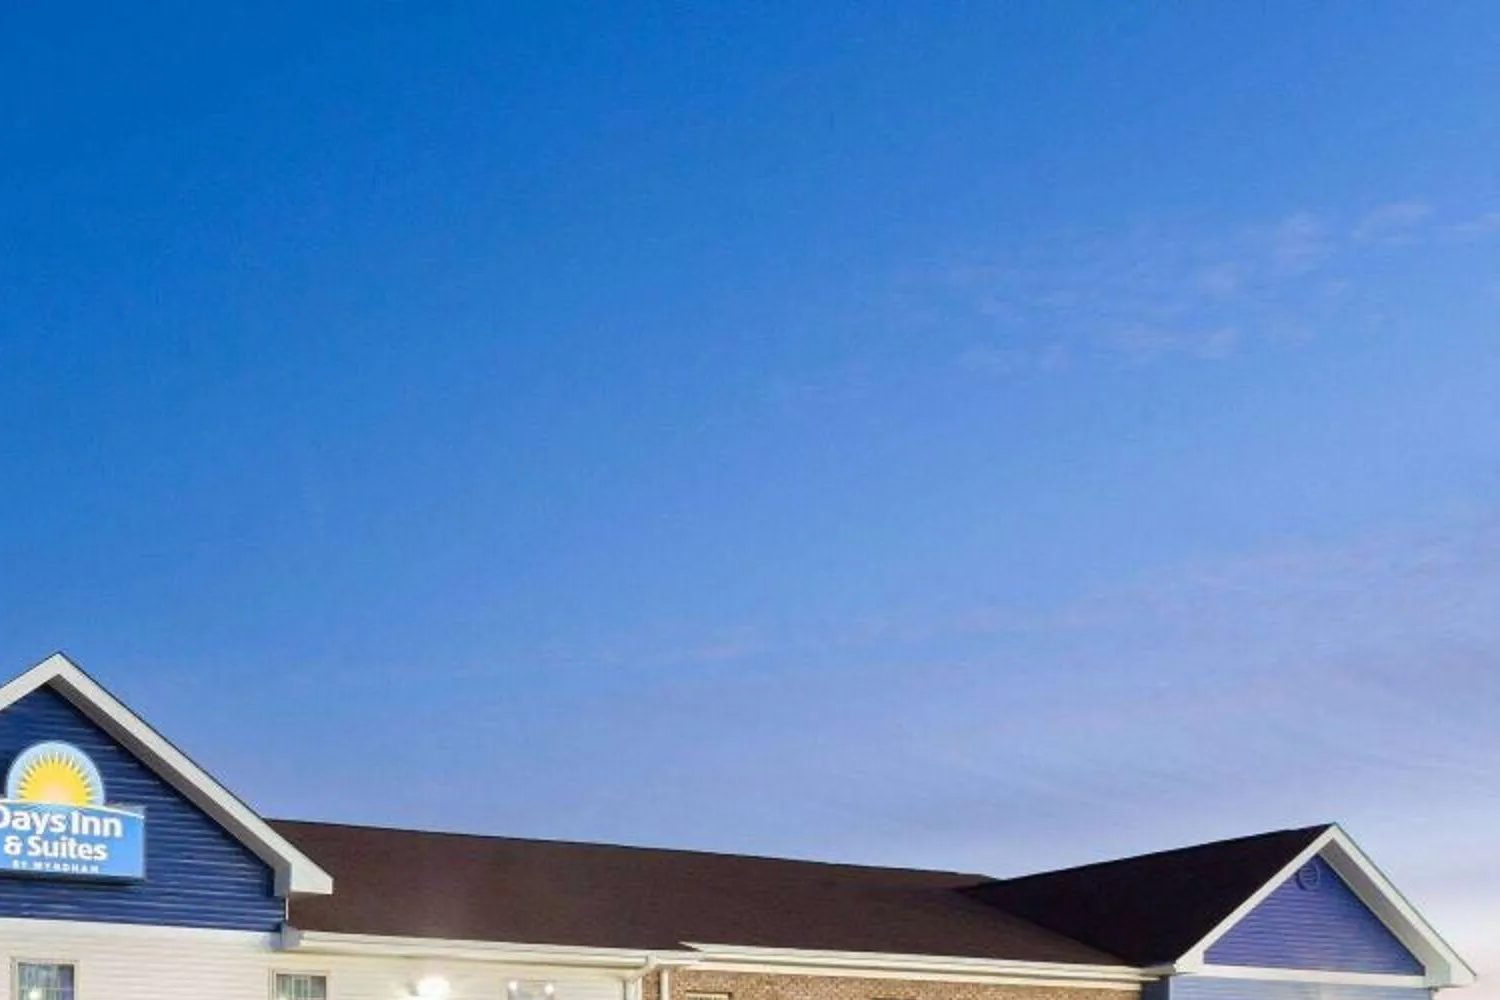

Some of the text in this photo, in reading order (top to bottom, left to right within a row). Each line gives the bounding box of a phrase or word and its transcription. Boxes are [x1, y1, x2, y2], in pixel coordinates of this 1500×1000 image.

[71, 810, 123, 837] Inn
[3, 835, 108, 860] & Suites
